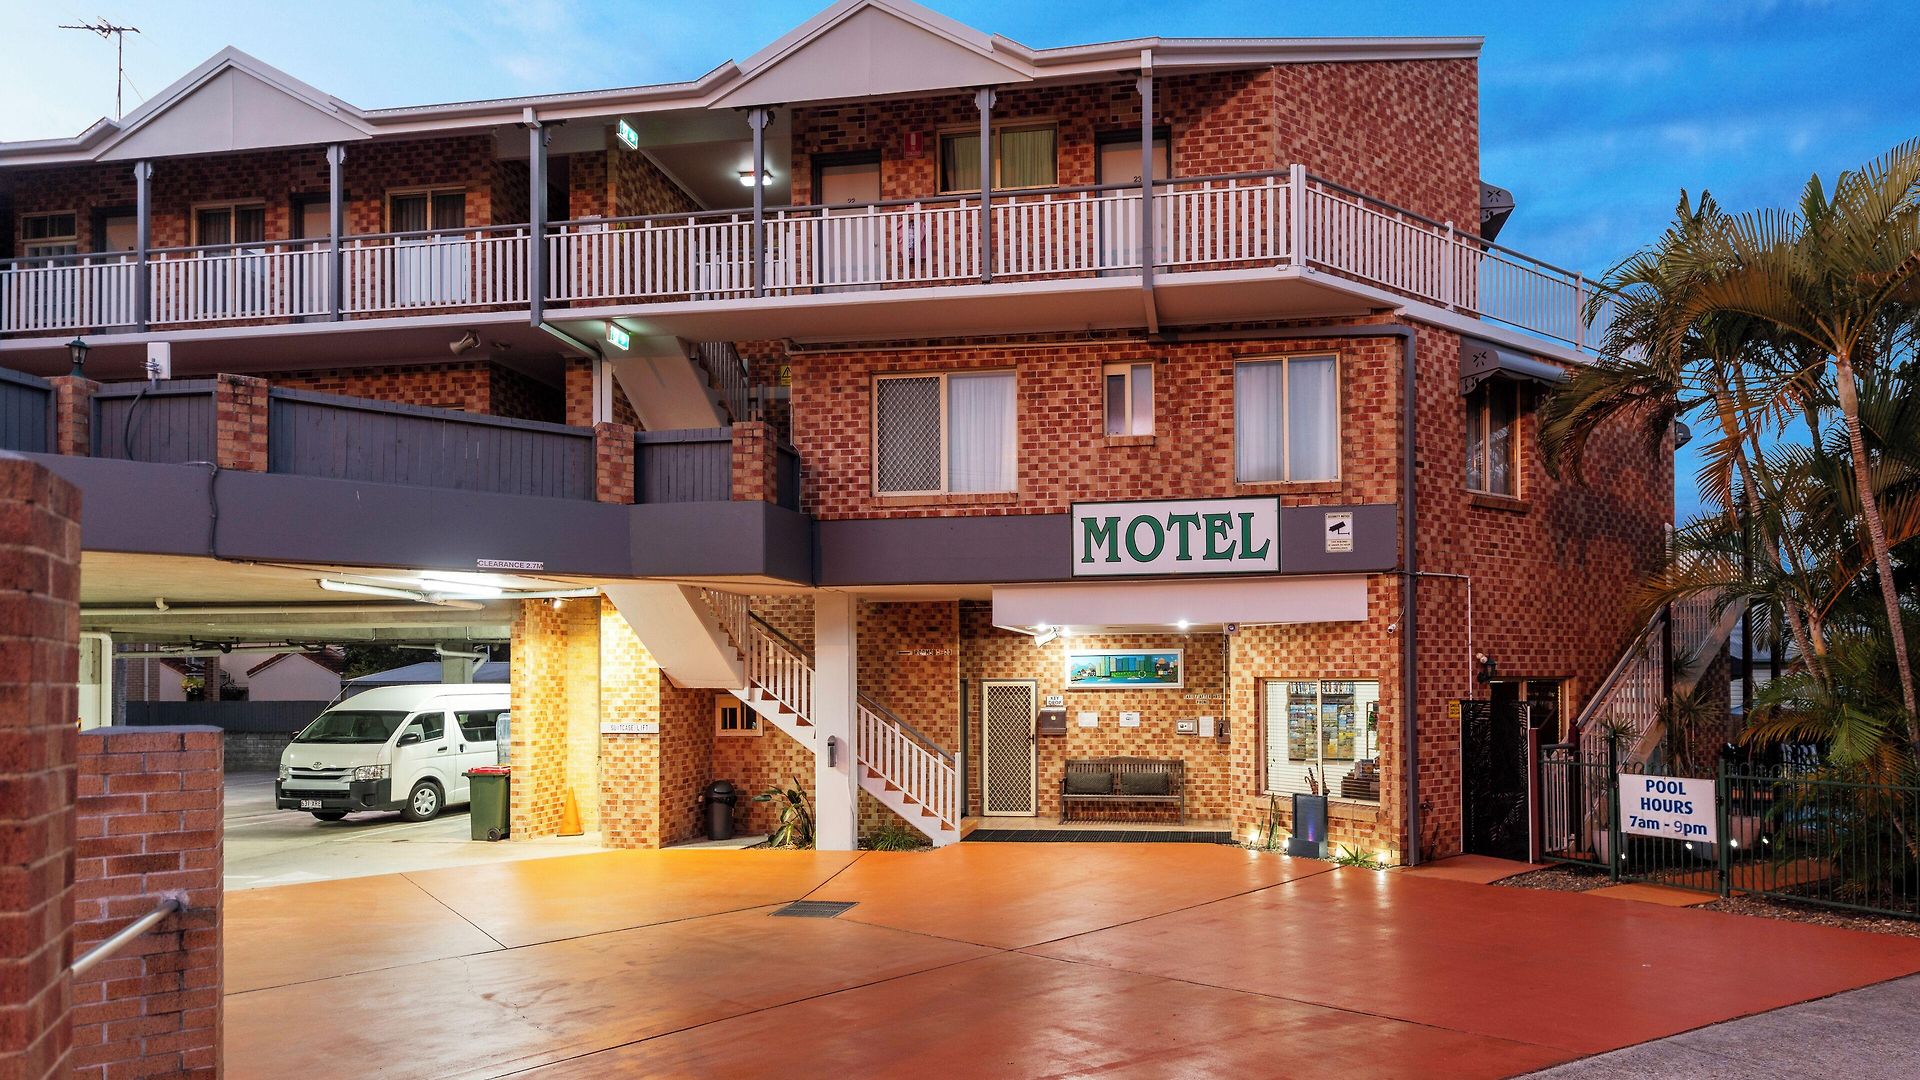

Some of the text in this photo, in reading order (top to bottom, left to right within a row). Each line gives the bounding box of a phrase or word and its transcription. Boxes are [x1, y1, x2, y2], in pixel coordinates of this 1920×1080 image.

[1081, 511, 1271, 563] MOTEL
[478, 560, 524, 568] CLEARANCE
[1646, 779, 1687, 796] POOL
[1640, 797, 1694, 815] HOURS
[1629, 815, 1660, 830] 7am
[1674, 820, 1708, 836] 9pm
